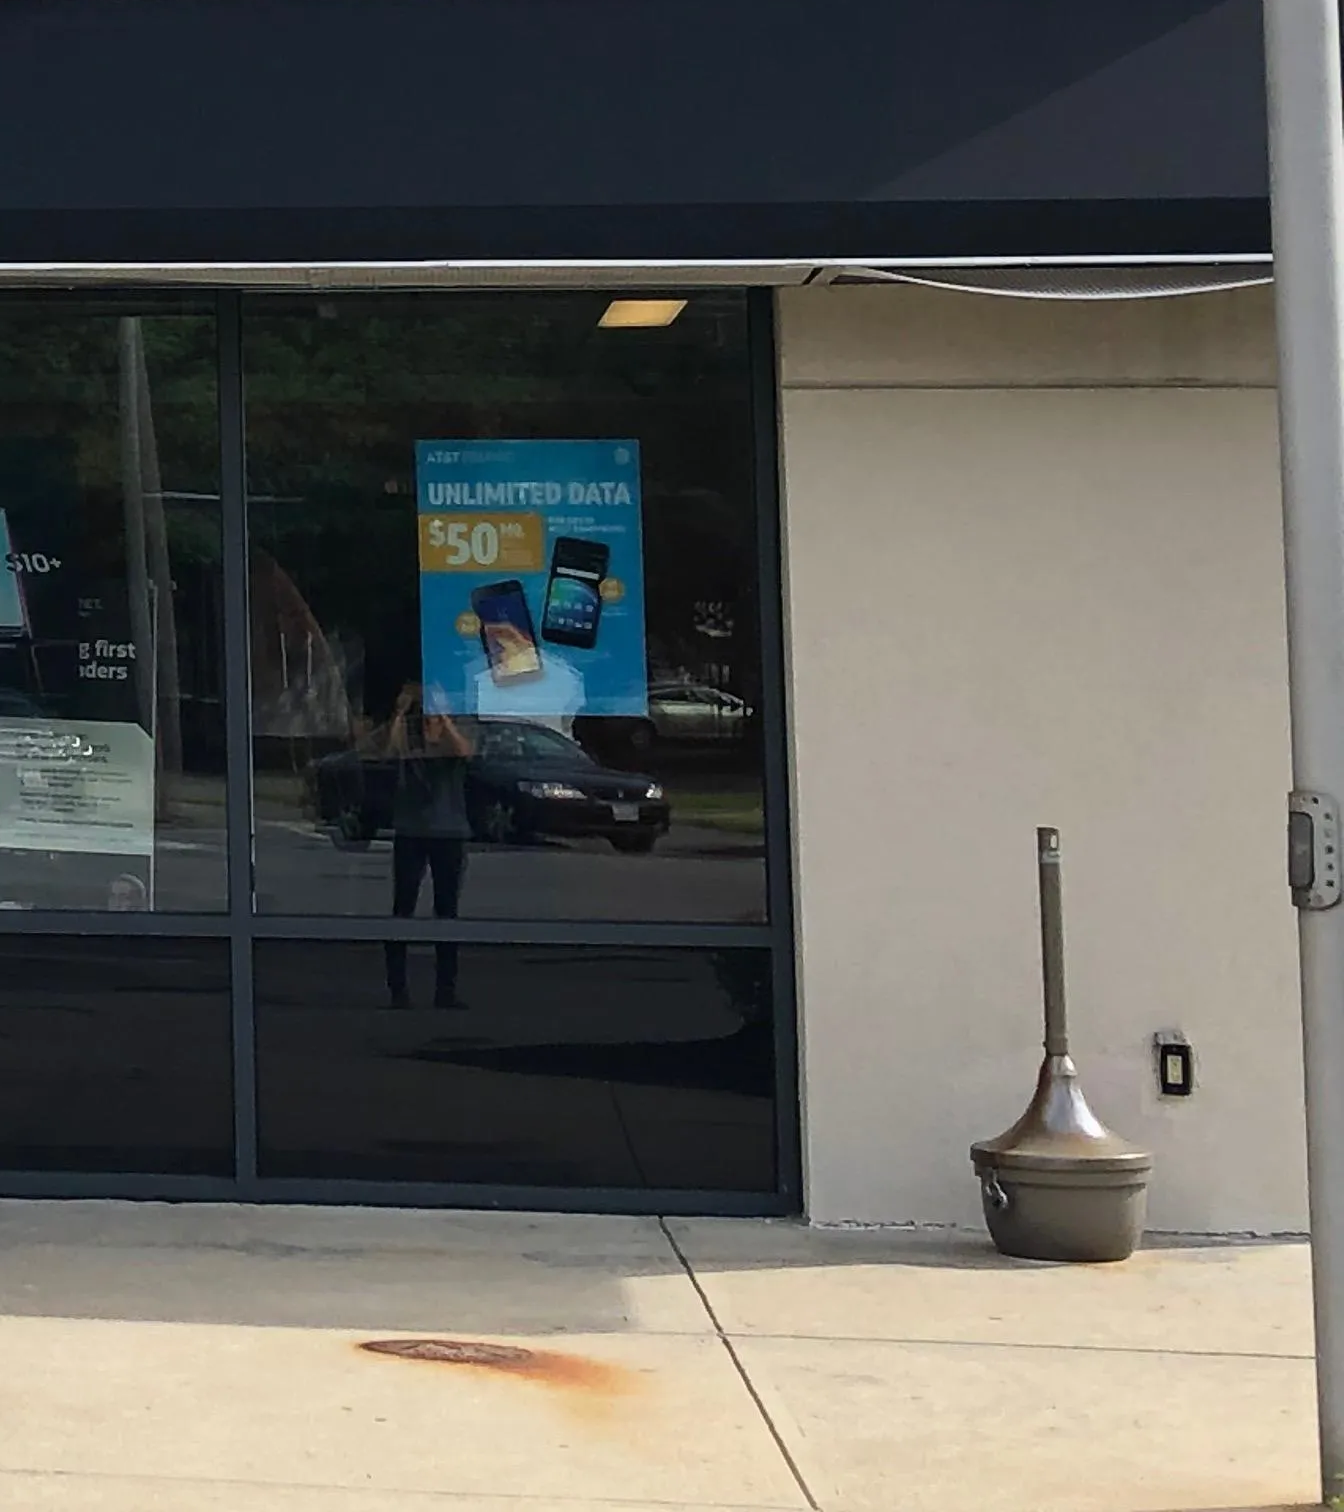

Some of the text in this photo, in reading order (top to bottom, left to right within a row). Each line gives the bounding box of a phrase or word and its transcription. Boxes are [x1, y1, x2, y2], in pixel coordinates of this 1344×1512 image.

[426, 450, 461, 464] AT&T
[427, 481, 632, 506] UNLIMITED DATA
[428, 518, 499, 567] $50
[5, 553, 62, 573] S10+
[94, 638, 137, 660] first
